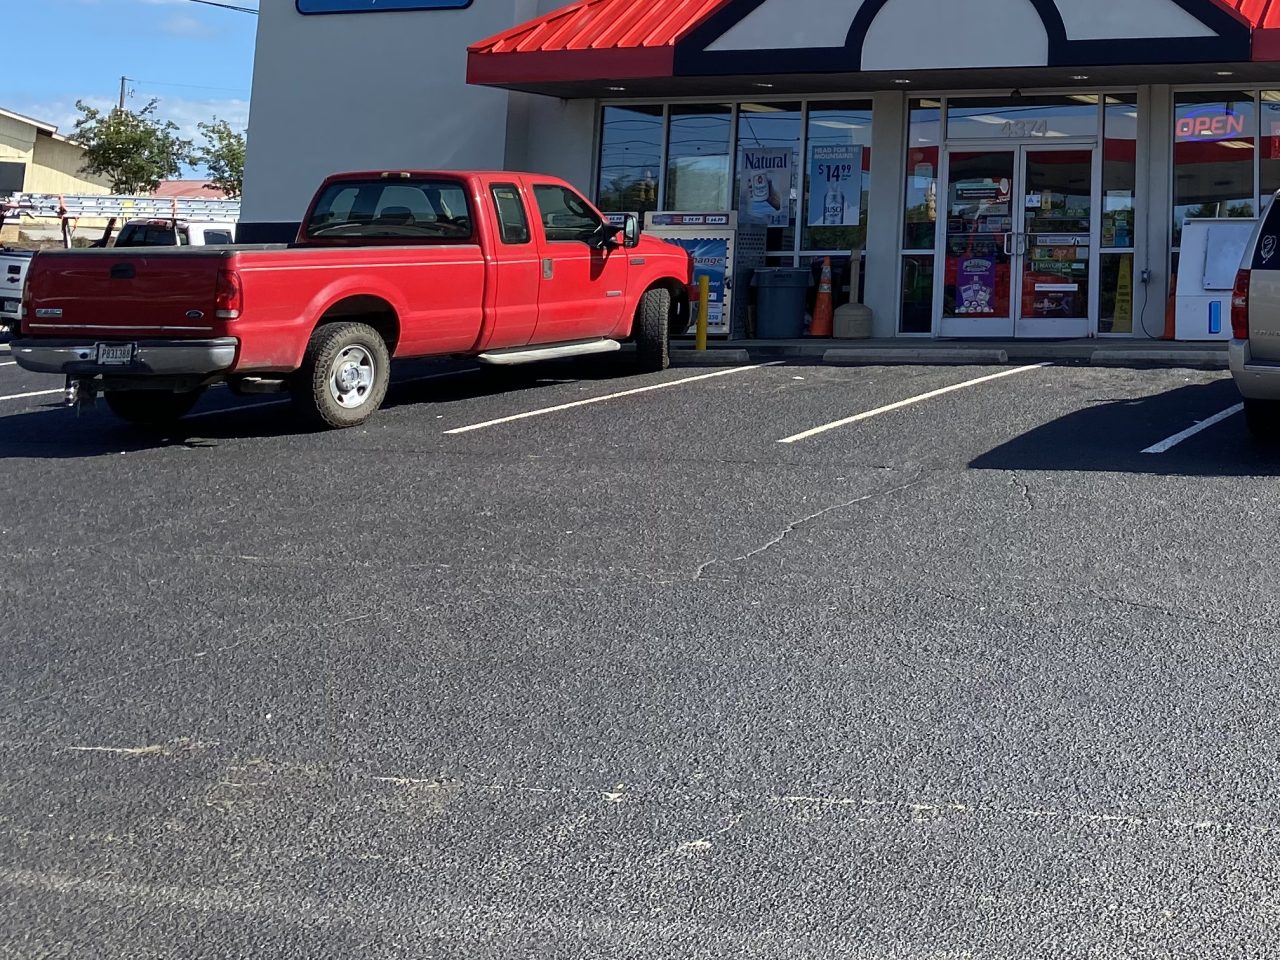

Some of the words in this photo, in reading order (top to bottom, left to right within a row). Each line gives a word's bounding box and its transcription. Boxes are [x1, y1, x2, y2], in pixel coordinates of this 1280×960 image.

[1000, 120, 1048, 137] 4374
[1175, 115, 1245, 137] OPEN
[745, 153, 788, 170] Natural
